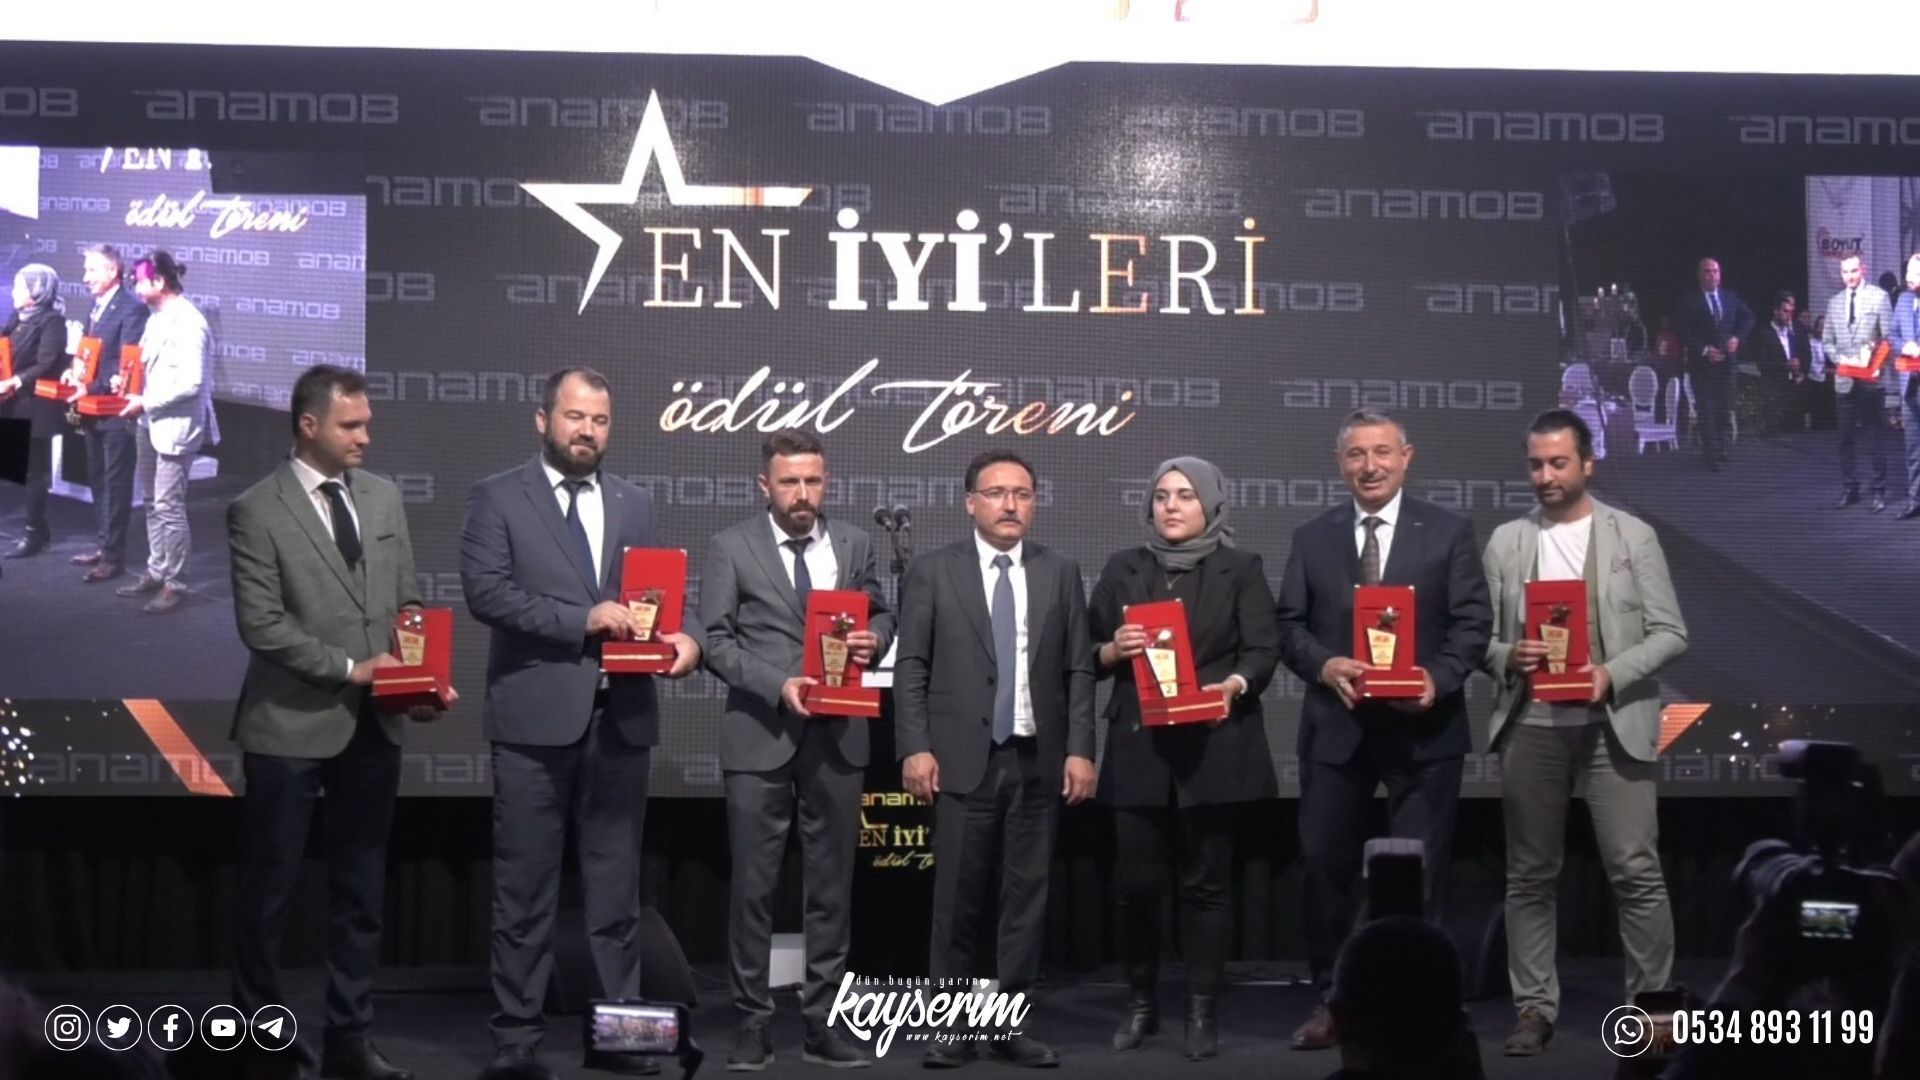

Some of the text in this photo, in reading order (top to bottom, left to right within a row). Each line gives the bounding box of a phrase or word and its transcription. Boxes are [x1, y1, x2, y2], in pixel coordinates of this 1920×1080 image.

[643, 226, 791, 310] EN
[659, 357, 878, 433] ödül
[860, 830, 887, 847] EN
